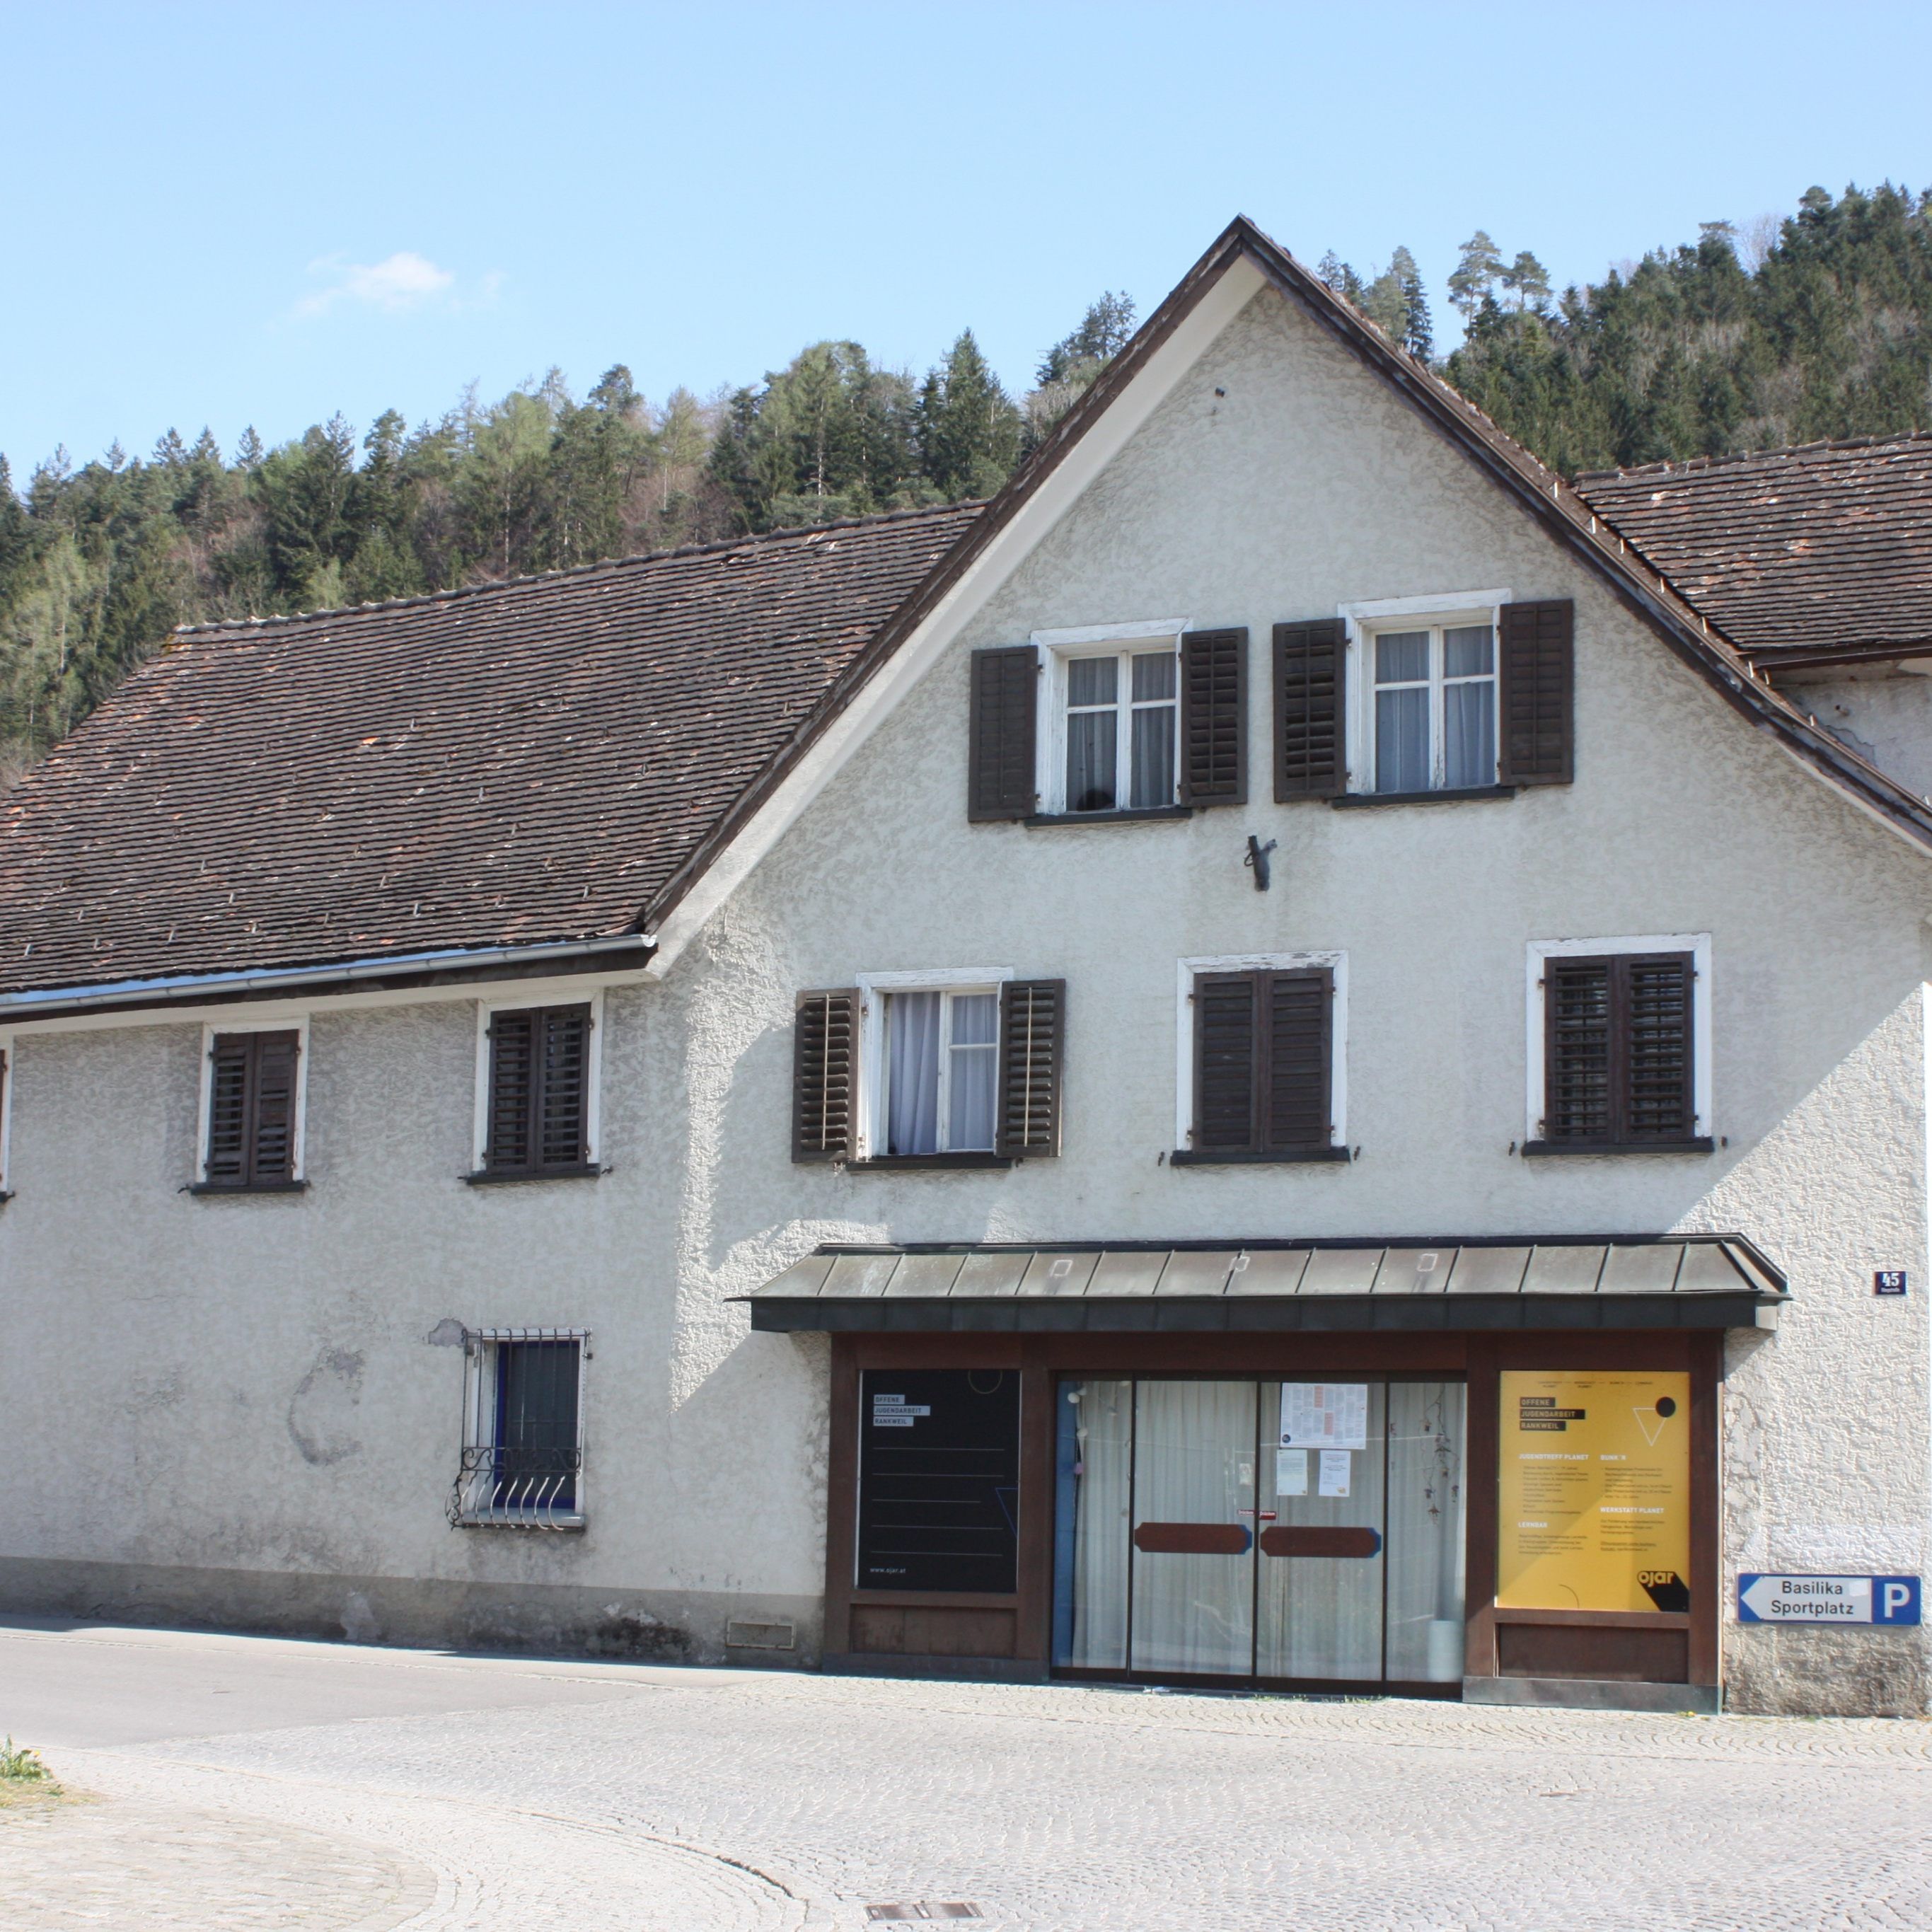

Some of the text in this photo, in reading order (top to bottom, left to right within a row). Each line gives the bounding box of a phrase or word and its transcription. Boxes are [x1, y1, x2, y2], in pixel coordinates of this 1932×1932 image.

[1882, 1273, 1899, 1287] 45
[1638, 1571, 1674, 1587] ojar
[1781, 1580, 1843, 1595] Basilika
[1771, 1600, 1854, 1617] Sportplatz
[1884, 1583, 1910, 1618] P
